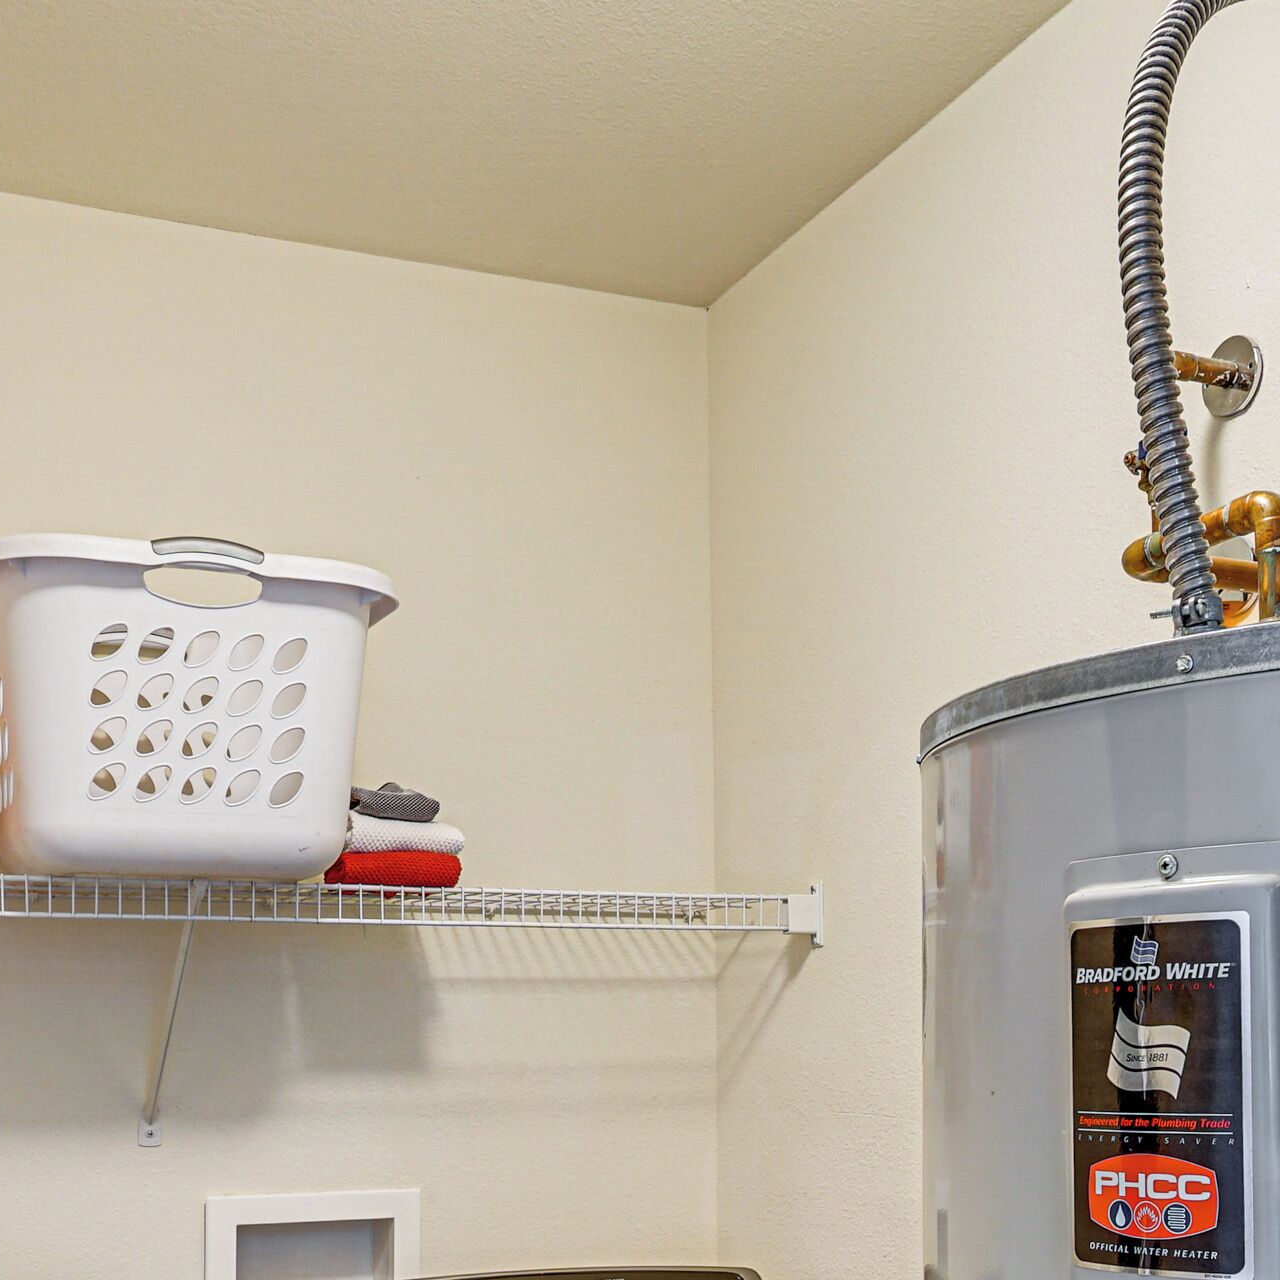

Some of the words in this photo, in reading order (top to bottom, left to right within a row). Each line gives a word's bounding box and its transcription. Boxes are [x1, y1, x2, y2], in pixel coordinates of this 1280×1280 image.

[1075, 965, 1161, 985] BRADFORD
[1165, 962, 1231, 980] WHITE
[1148, 1053, 1169, 1063] 1881
[1079, 1115, 1118, 1127] Engineered
[1120, 1116, 1133, 1127] for
[1134, 1117, 1149, 1128] the
[1151, 1118, 1197, 1130] Plumbing
[1200, 1118, 1231, 1129] Trade
[1077, 1133, 1144, 1144] ENERGY
[1163, 1136, 1235, 1146] SAVER
[1094, 1170, 1212, 1201] PHCC
[1089, 1241, 1130, 1254] OFFICIAL
[1133, 1246, 1169, 1258] WATER
[1173, 1249, 1219, 1261] HEATER
